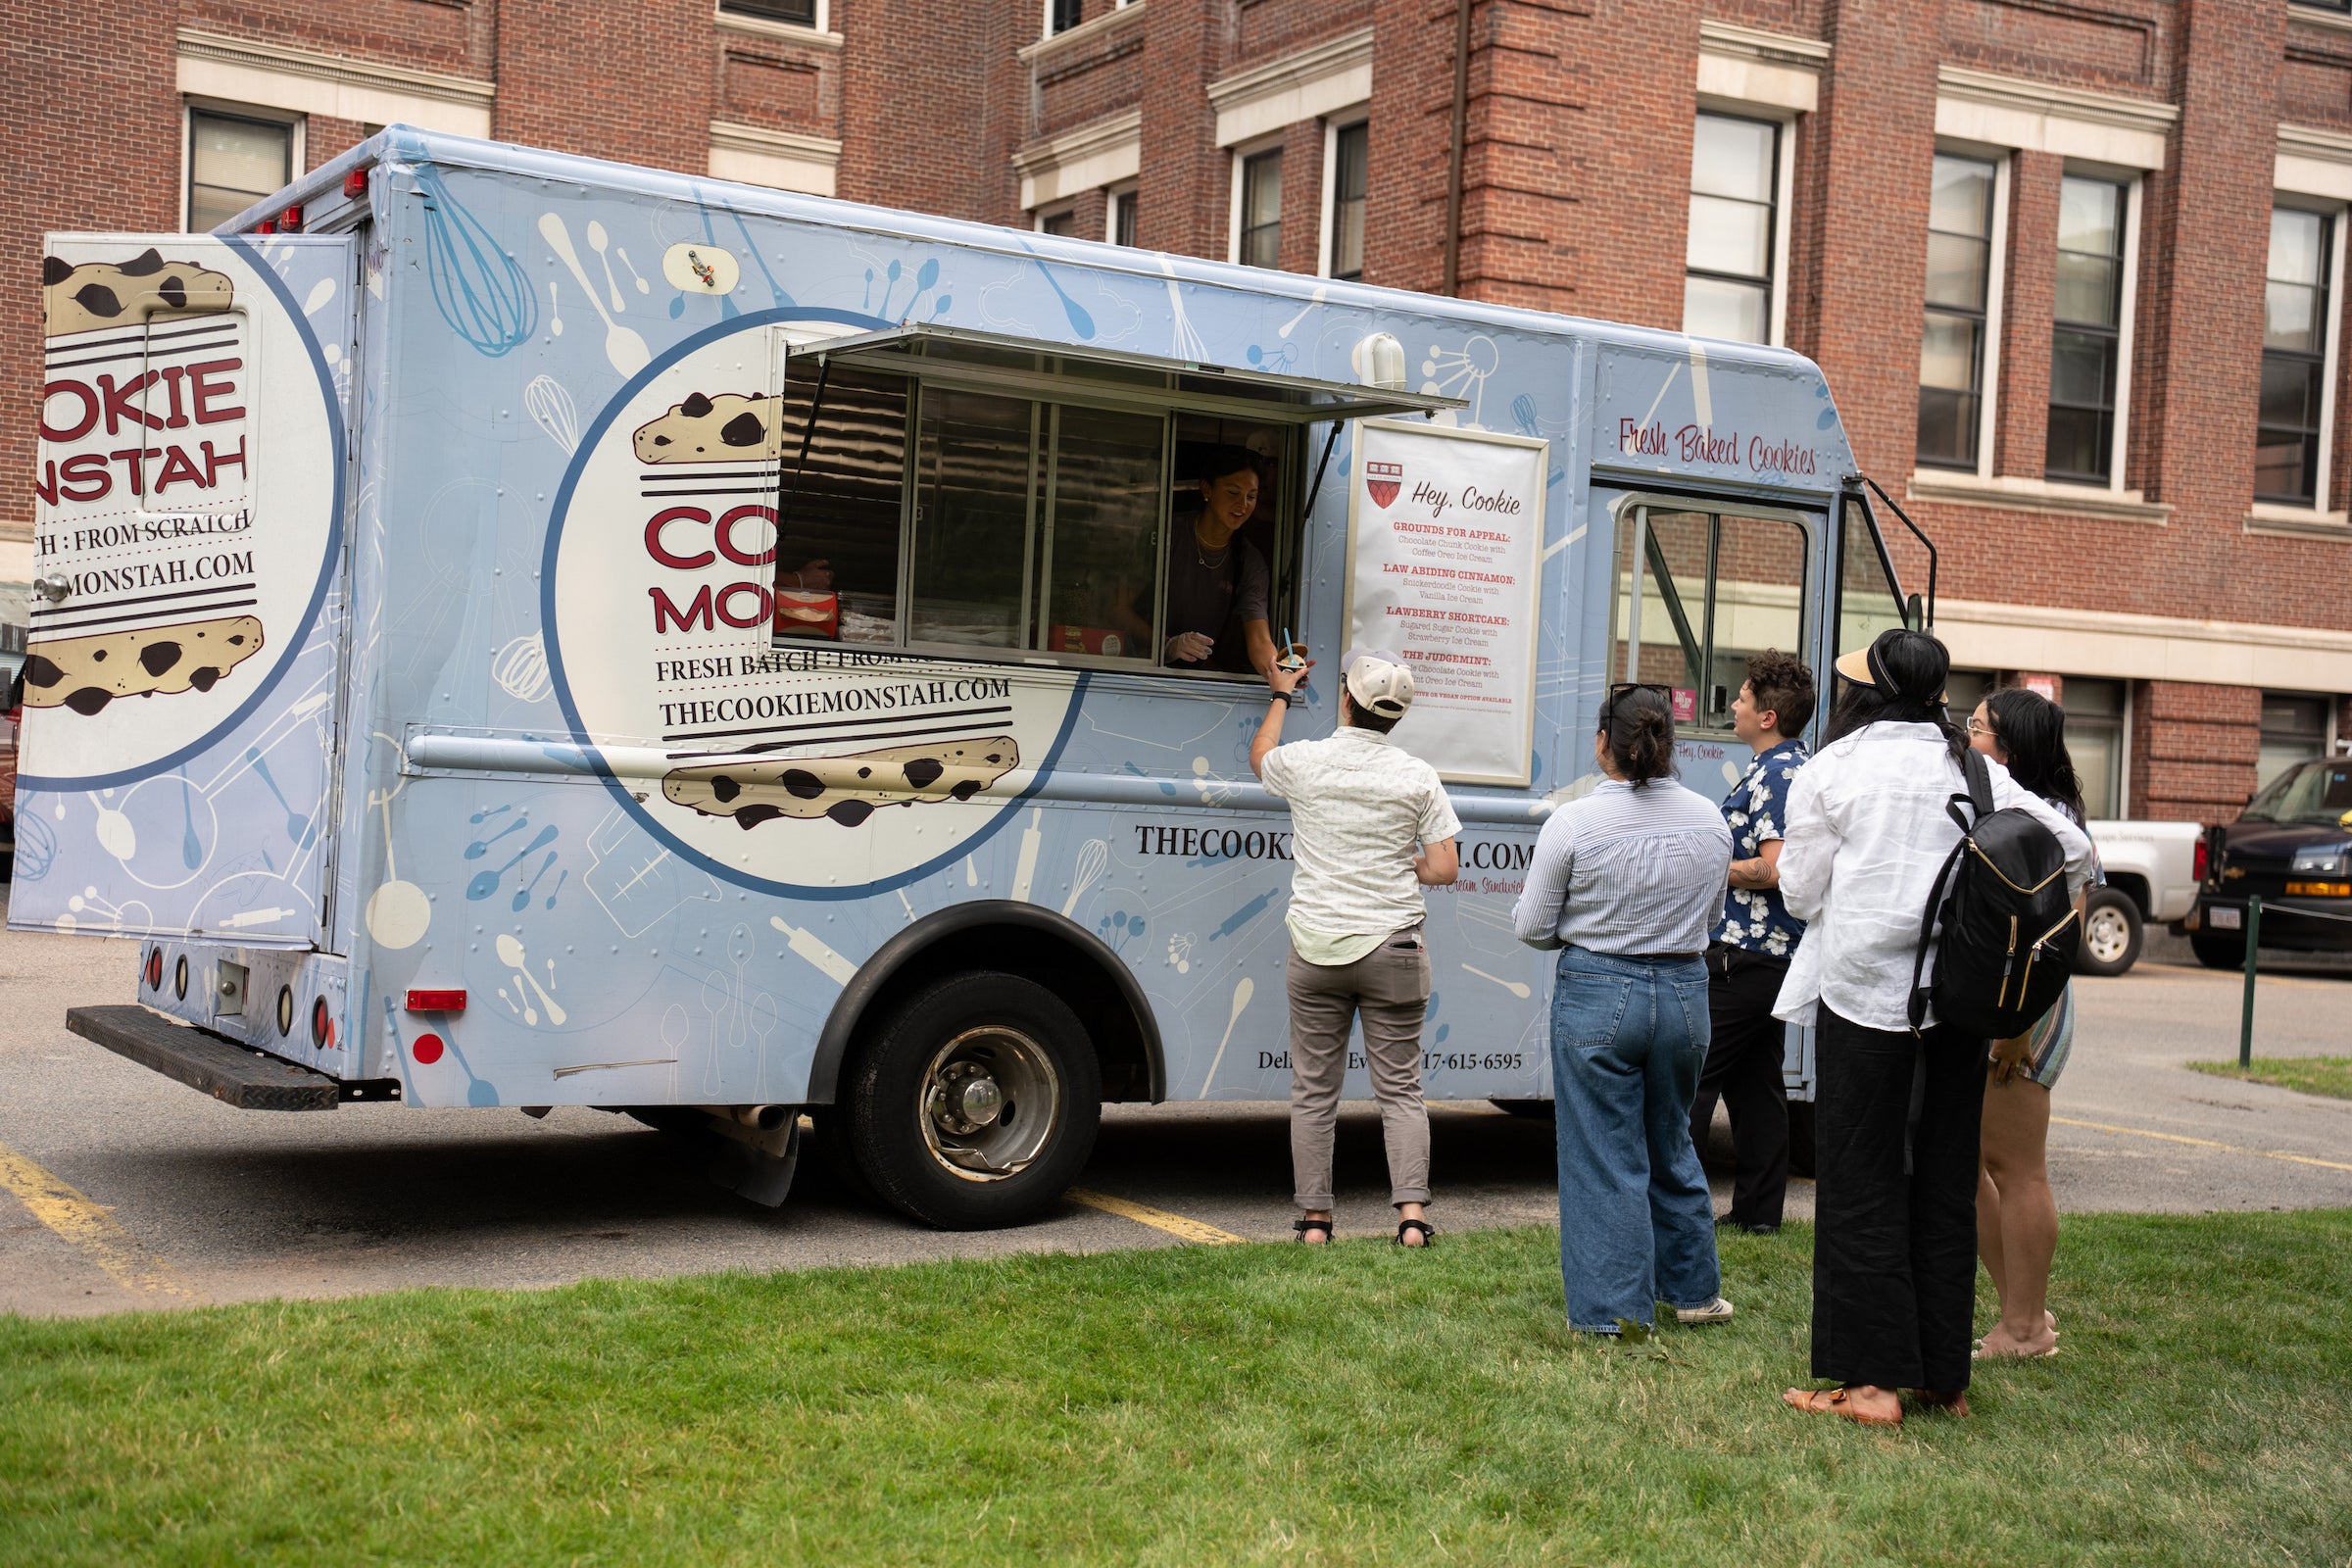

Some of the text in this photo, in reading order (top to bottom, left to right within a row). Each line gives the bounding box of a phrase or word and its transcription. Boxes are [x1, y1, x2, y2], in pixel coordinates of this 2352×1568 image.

[39, 357, 246, 441] OKIE
[1620, 417, 1816, 475] Fresh Baked Cookies
[1411, 481, 1521, 518] Hey, Cookie
[74, 523, 139, 551] FROM
[145, 509, 252, 541] SCRATCH
[1394, 521, 1511, 543] GROUNDS FOR APPEAL:
[1398, 535, 1506, 555] Chocolate Chunk Cookie with
[1412, 548, 1494, 564] Coffee Oreo Ice Cream
[1383, 564, 1516, 585] LAW ABIDING CINNAMON:
[1403, 578, 1499, 595] Snickerdoodle Cookie with
[1420, 590, 1484, 605] Vanilla Ice Cream
[1386, 606, 1510, 626] LAWBERRY SHORTCAKE:
[1400, 620, 1497, 637] Sugared Sugar Cookie with
[1408, 632, 1489, 647] Strawberry Ice Cream
[656, 657, 733, 682] FRESH
[740, 651, 818, 675] BATCH
[1402, 650, 1492, 666] THE JUDGEMINT:
[1418, 665, 1455, 676] Chocolate
[1456, 667, 1482, 678] Cookie
[1483, 670, 1499, 679] with
[1425, 676, 1443, 685] Oreo
[1458, 679, 1483, 688] Cream
[660, 677, 1011, 726] THECOOKIEMONSTAH.COM
[1697, 745, 1725, 760] Cookie
